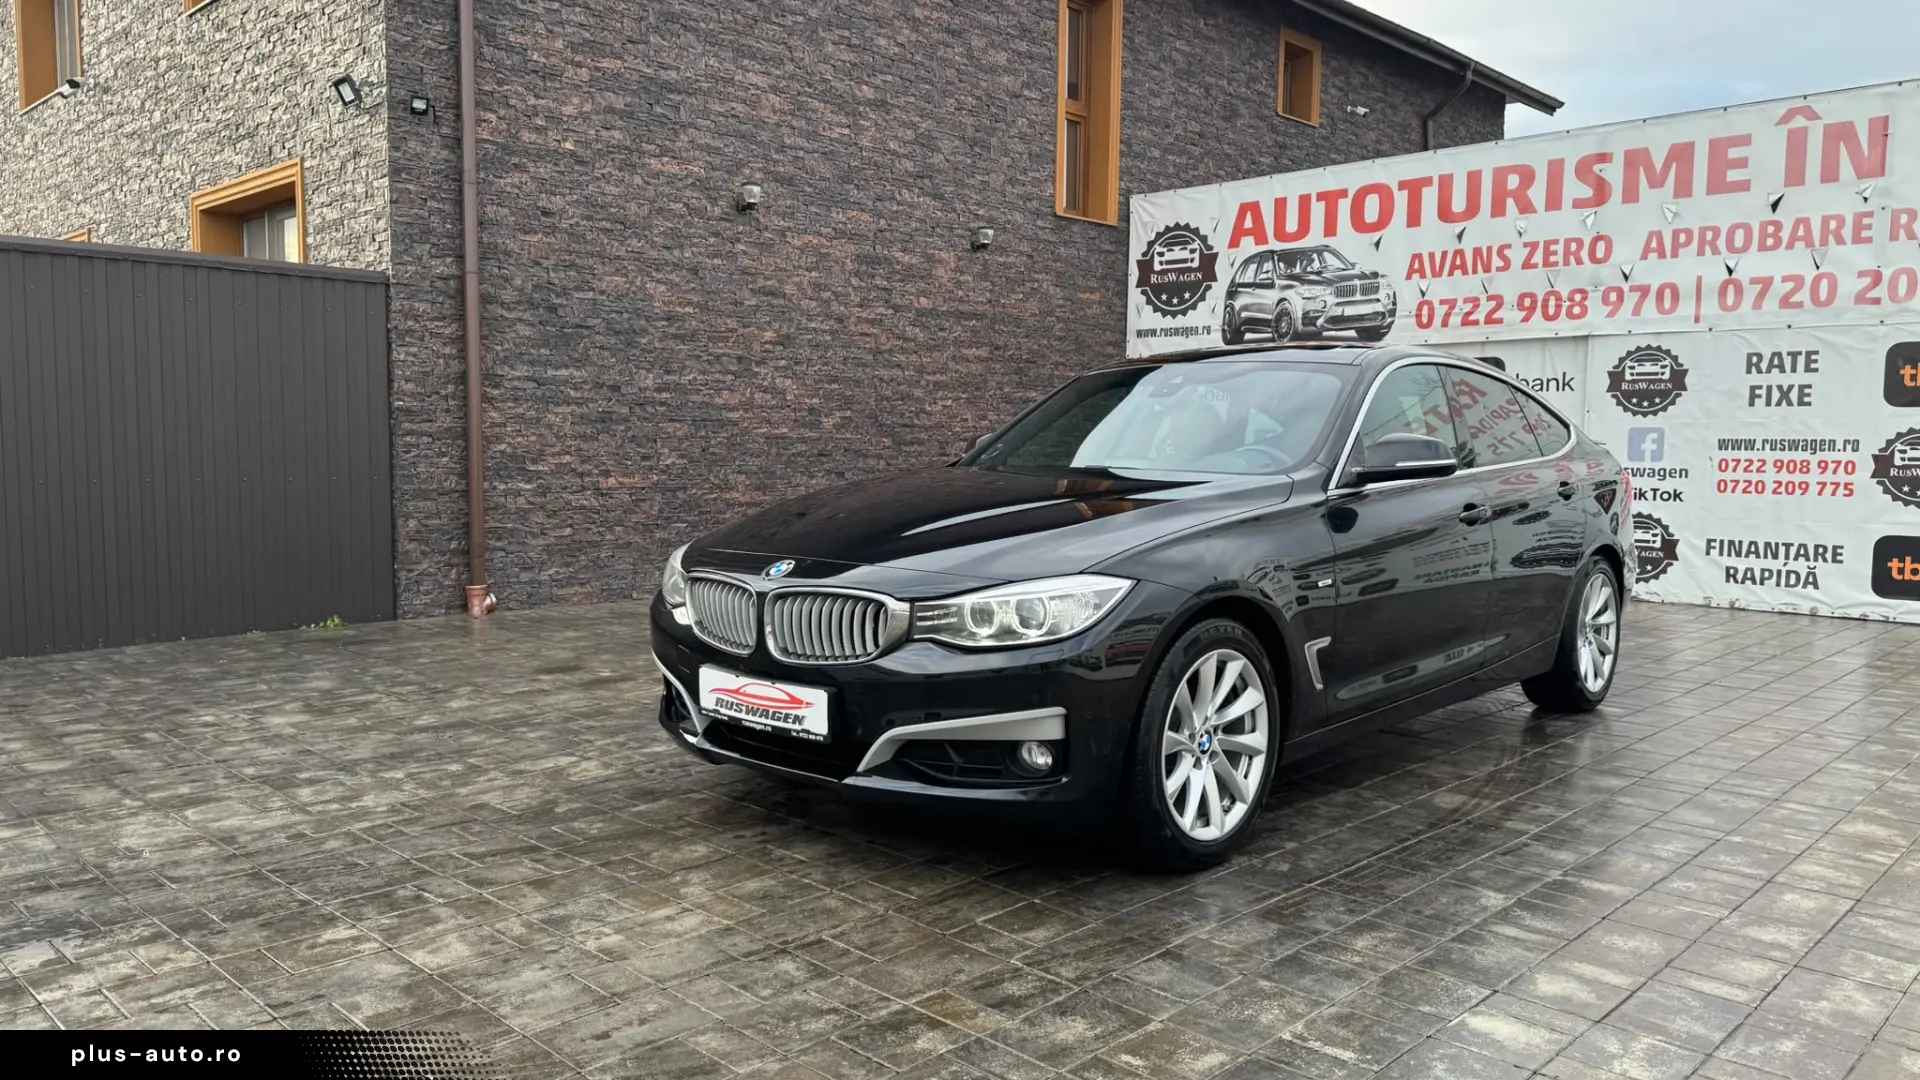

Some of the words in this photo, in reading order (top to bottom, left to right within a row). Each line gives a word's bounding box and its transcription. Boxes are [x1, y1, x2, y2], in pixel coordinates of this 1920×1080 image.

[1228, 133, 1752, 249] AUTOTURISME
[1775, 105, 1889, 187] ÎN
[1405, 243, 1512, 281] AVANS
[1521, 233, 1613, 270] ZERO
[1639, 210, 1874, 261] APROBARE
[1415, 294, 1504, 330] 0722
[1516, 288, 1589, 323] 908
[1601, 282, 1680, 319] 970
[1717, 272, 1838, 312] 0720
[1136, 325, 1211, 338] www.ruswagen.ro
[1745, 350, 1820, 375] RATE
[1748, 383, 1813, 408] FIXE
[1717, 438, 1860, 455] www.ruswagen.ro
[1717, 458, 1767, 474] 0722
[1772, 459, 1811, 475] 908
[1816, 460, 1857, 476] 970
[1632, 487, 1684, 502] ikTok
[1716, 479, 1766, 495] 0720
[1771, 480, 1810, 496] 209
[1815, 481, 1855, 497] 775
[714, 696, 808, 726] RUSWAGEN
